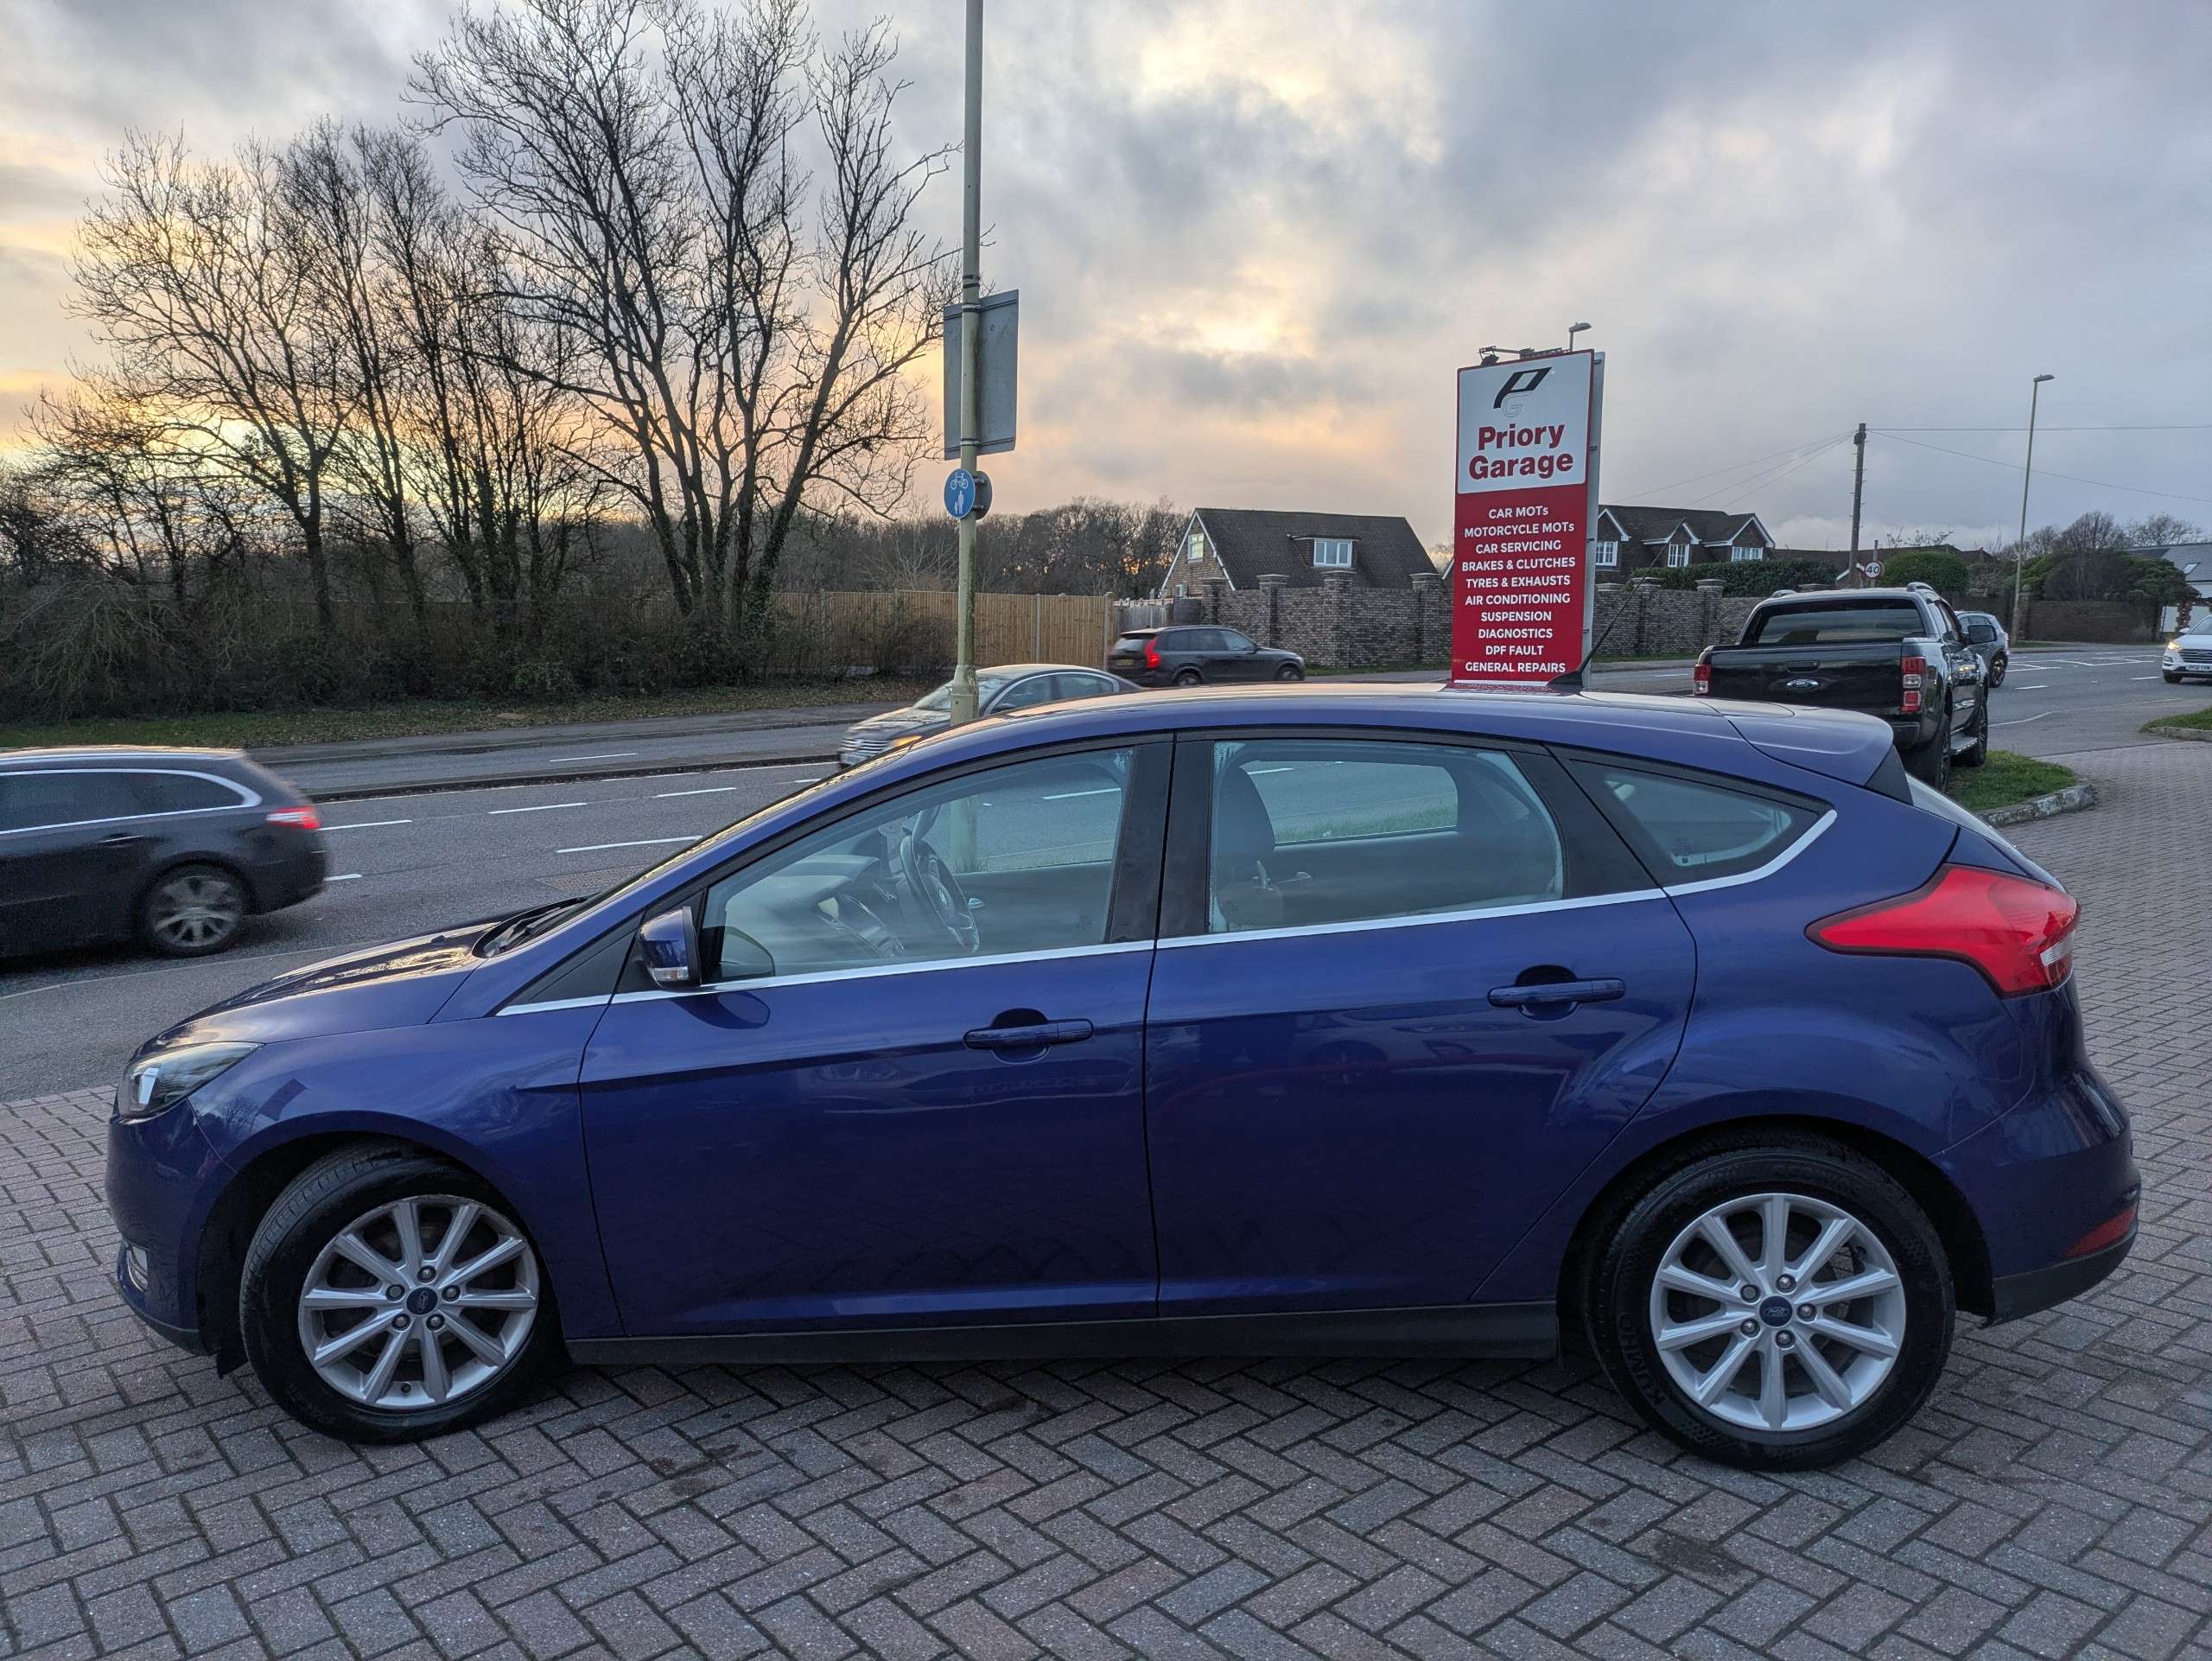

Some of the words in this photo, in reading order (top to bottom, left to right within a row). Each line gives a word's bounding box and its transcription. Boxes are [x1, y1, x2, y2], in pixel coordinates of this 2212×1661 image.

[1478, 423, 1565, 450] Priory
[1469, 453, 1573, 480] Garage
[1489, 508, 1512, 519] CAR
[1516, 506, 1549, 517] MOTs
[1465, 523, 1539, 538] MOTORCYCLE
[1542, 521, 1574, 533] MOTs
[1476, 544, 1498, 554] CAR
[1500, 539, 1561, 553] SERVICING
[1462, 561, 1503, 571] BRAKES
[1506, 560, 1514, 570] &
[1516, 557, 1575, 570] CLUTCHES
[1465, 578, 1498, 589] TYRES
[1501, 577, 1509, 588] &
[1511, 575, 1571, 588] EXHAUSTS
[1465, 595, 1483, 606] AIR
[1486, 593, 1571, 605] CONDITIONING
[1481, 611, 1552, 622] SUSPENSION
[1478, 628, 1553, 639] DIAGNOSTICS
[1485, 646, 1507, 655] DPF
[1510, 646, 1544, 656] FAULT
[1465, 662, 1515, 672] GENERAL
[1517, 662, 1566, 673] REPAIRS
